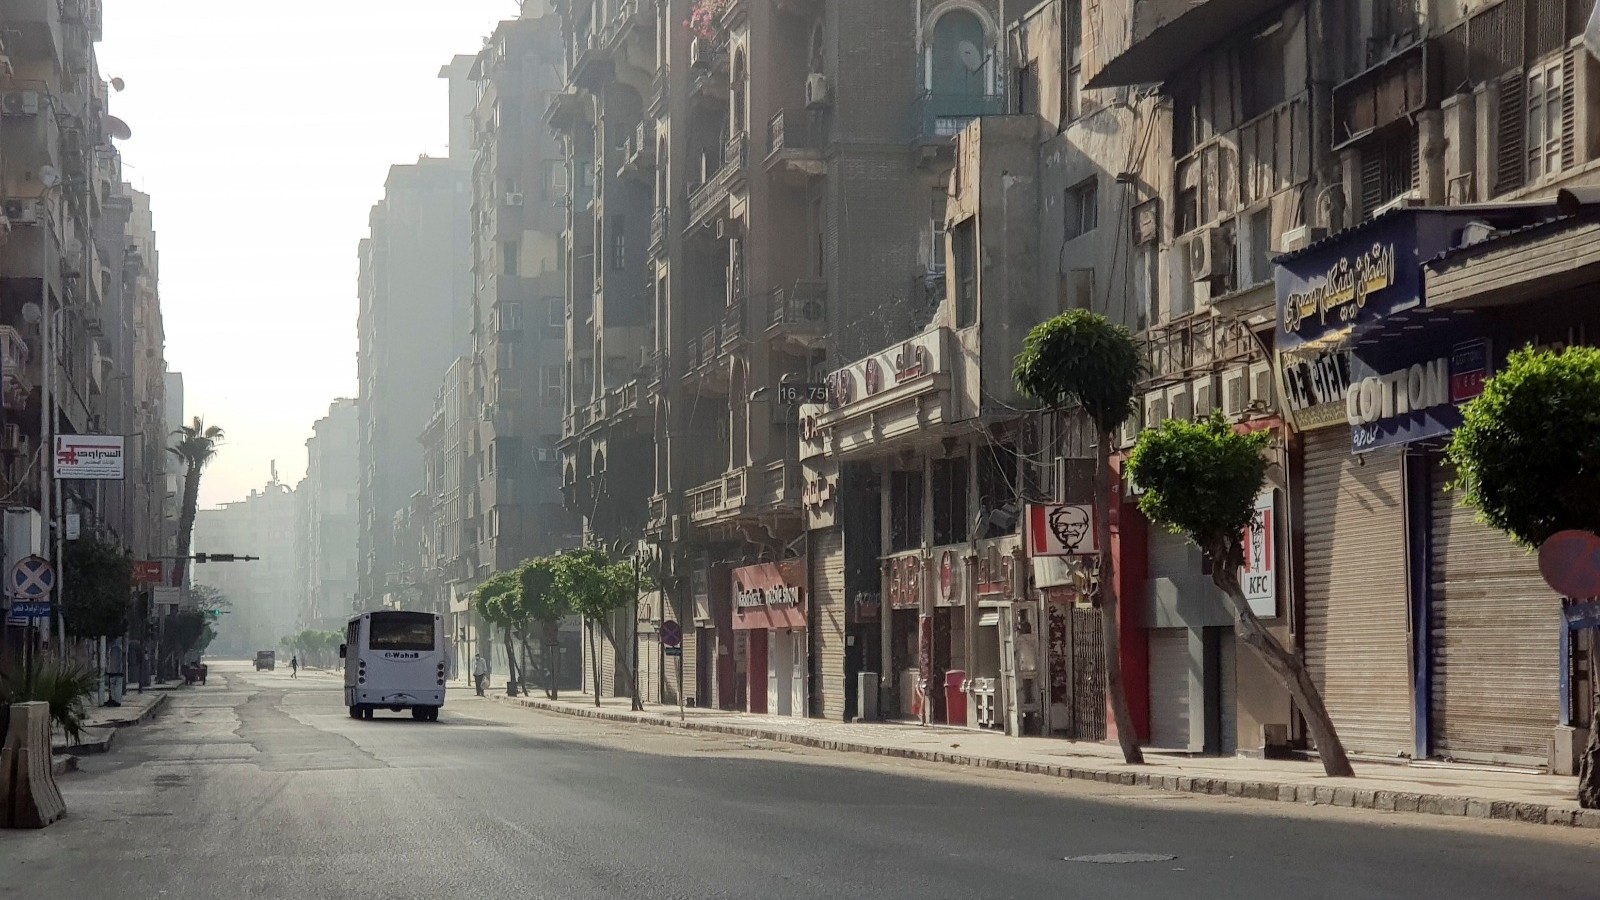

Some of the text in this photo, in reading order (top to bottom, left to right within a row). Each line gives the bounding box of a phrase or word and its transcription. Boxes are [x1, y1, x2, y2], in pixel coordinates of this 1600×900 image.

[1356, 242, 1395, 309] القطن
[781, 387, 825, 400] 16 75
[1283, 363, 1310, 411] LE
[1346, 357, 1449, 426] COTTON
[1248, 575, 1268, 594] KFC
